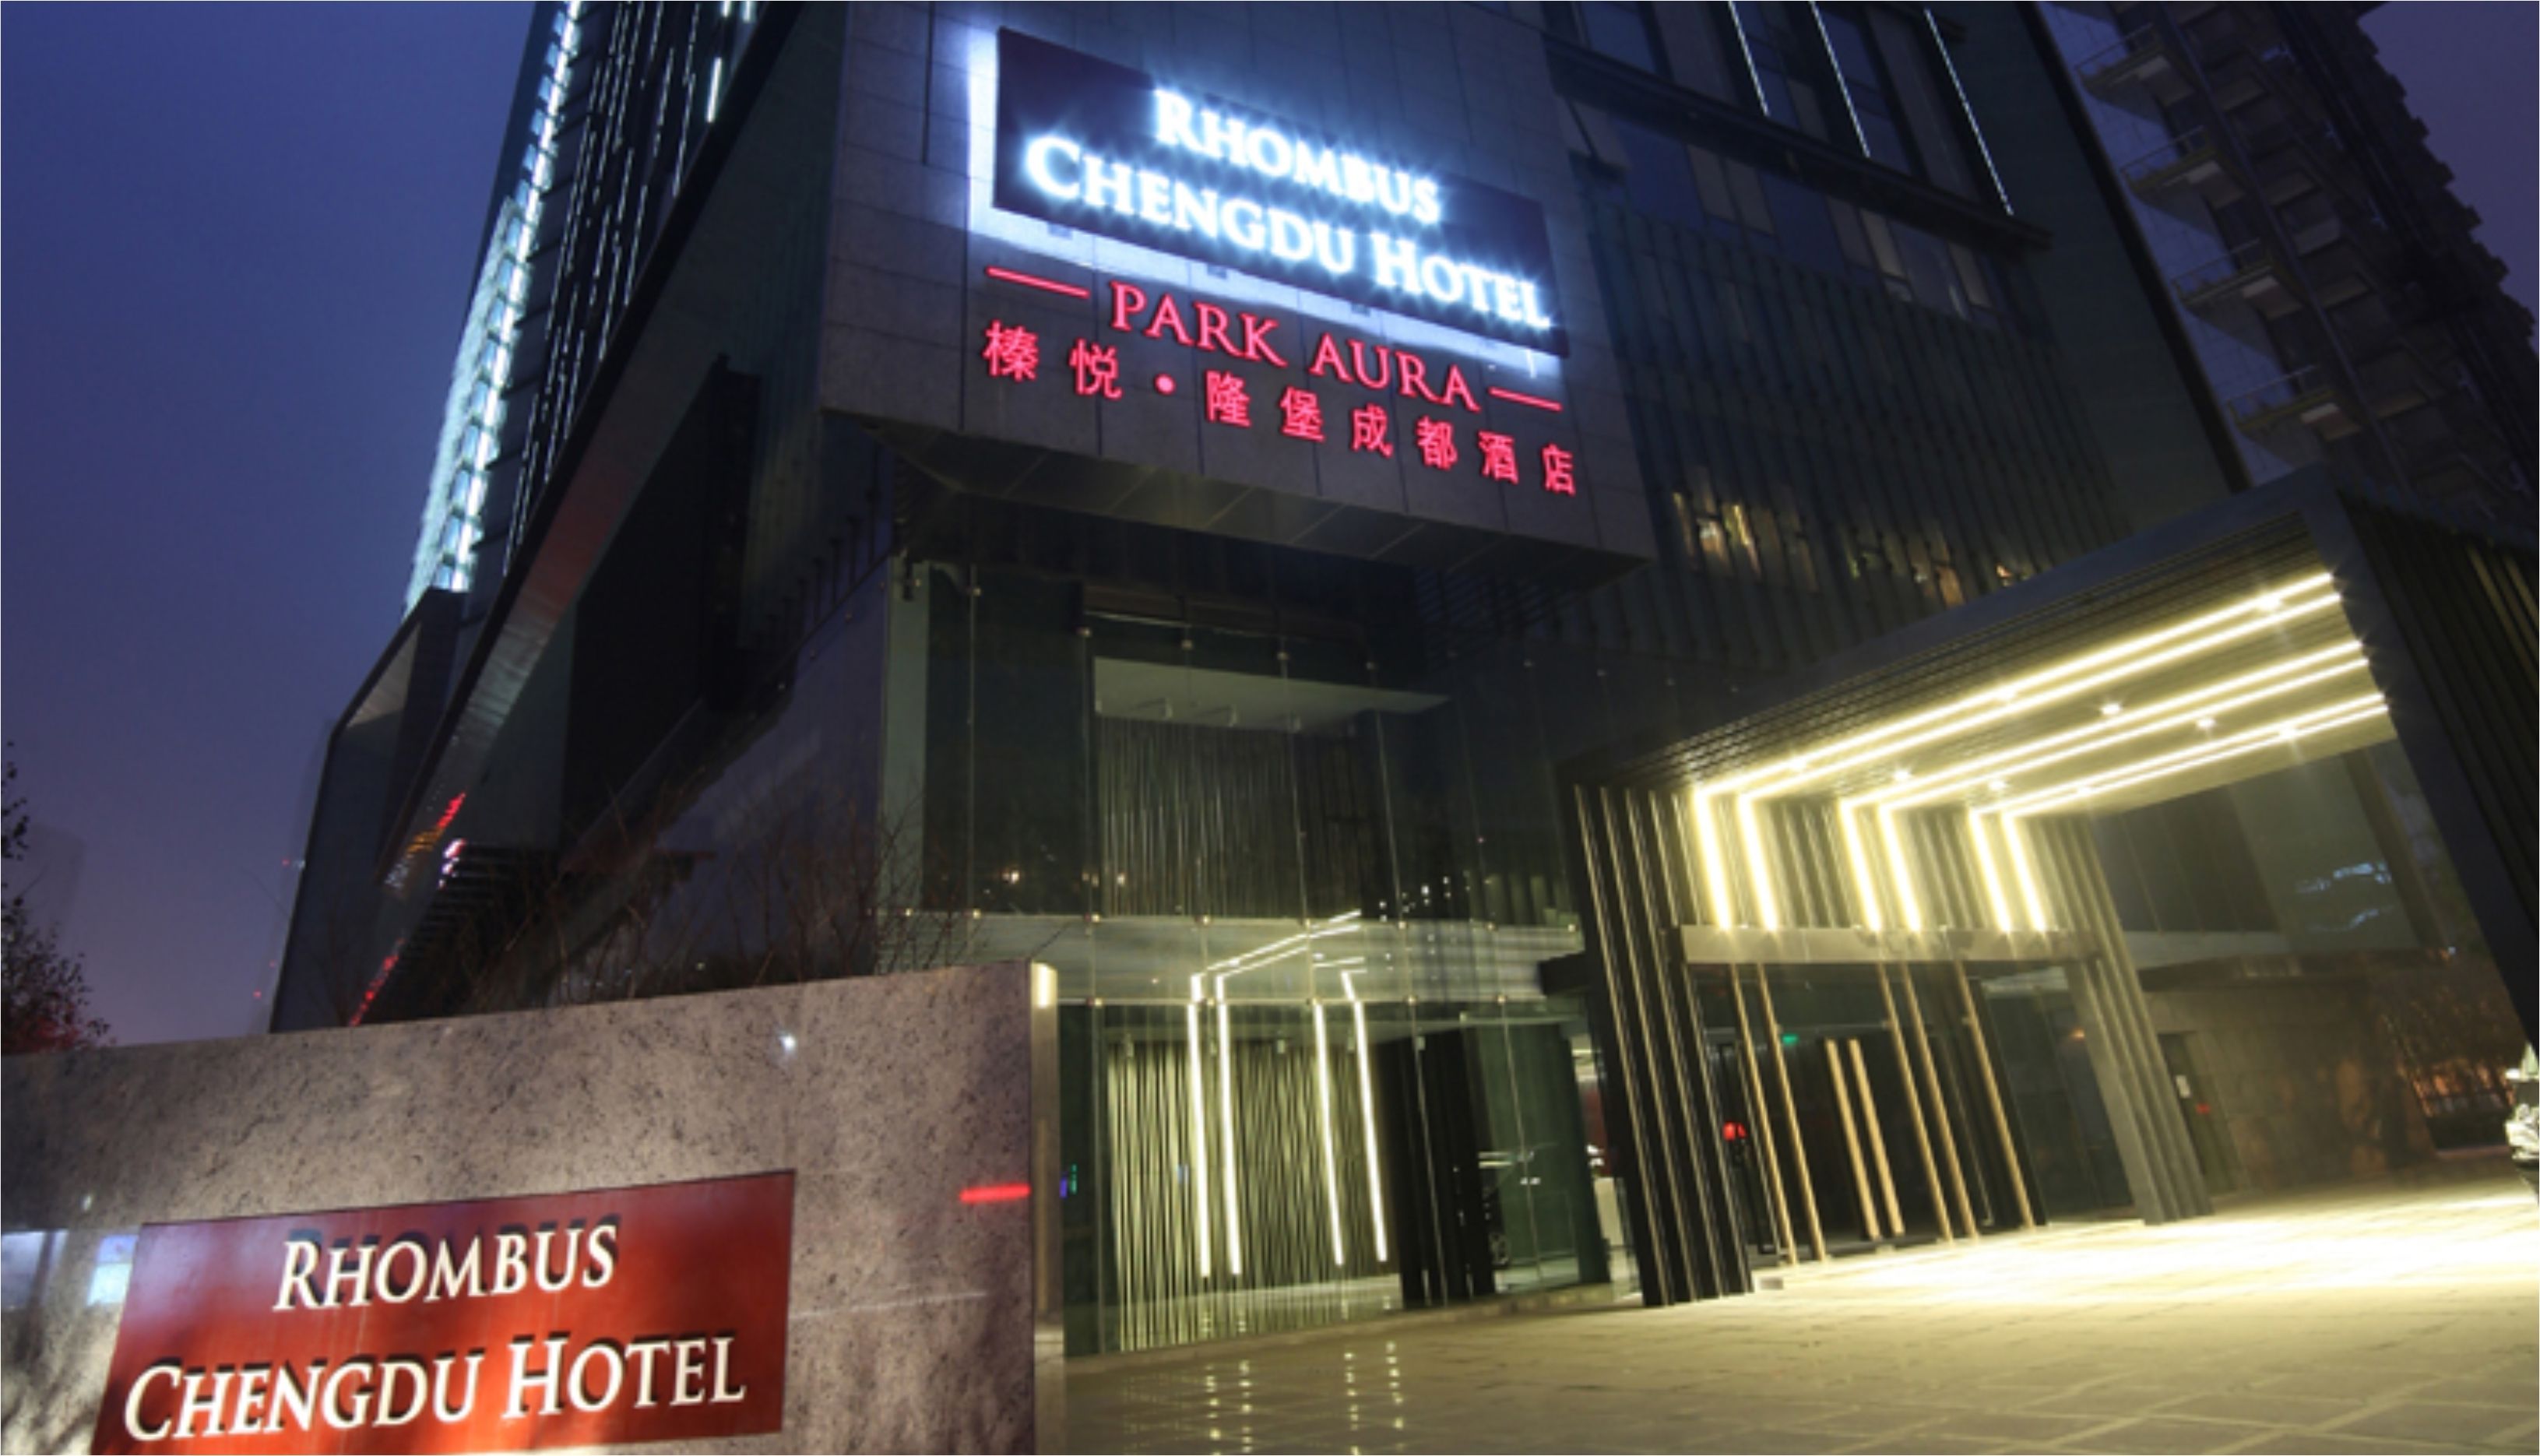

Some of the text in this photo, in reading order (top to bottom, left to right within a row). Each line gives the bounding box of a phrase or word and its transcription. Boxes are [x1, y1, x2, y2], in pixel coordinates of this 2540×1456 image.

[1154, 87, 1441, 225] RHOMBUS
[1024, 135, 1552, 329] CHENGDU HOTEL
[1109, 280, 1482, 413] PARK AURA
[271, 1224, 617, 1312] RHOMBUS
[123, 1338, 746, 1441] CHENGDU HOTEL
